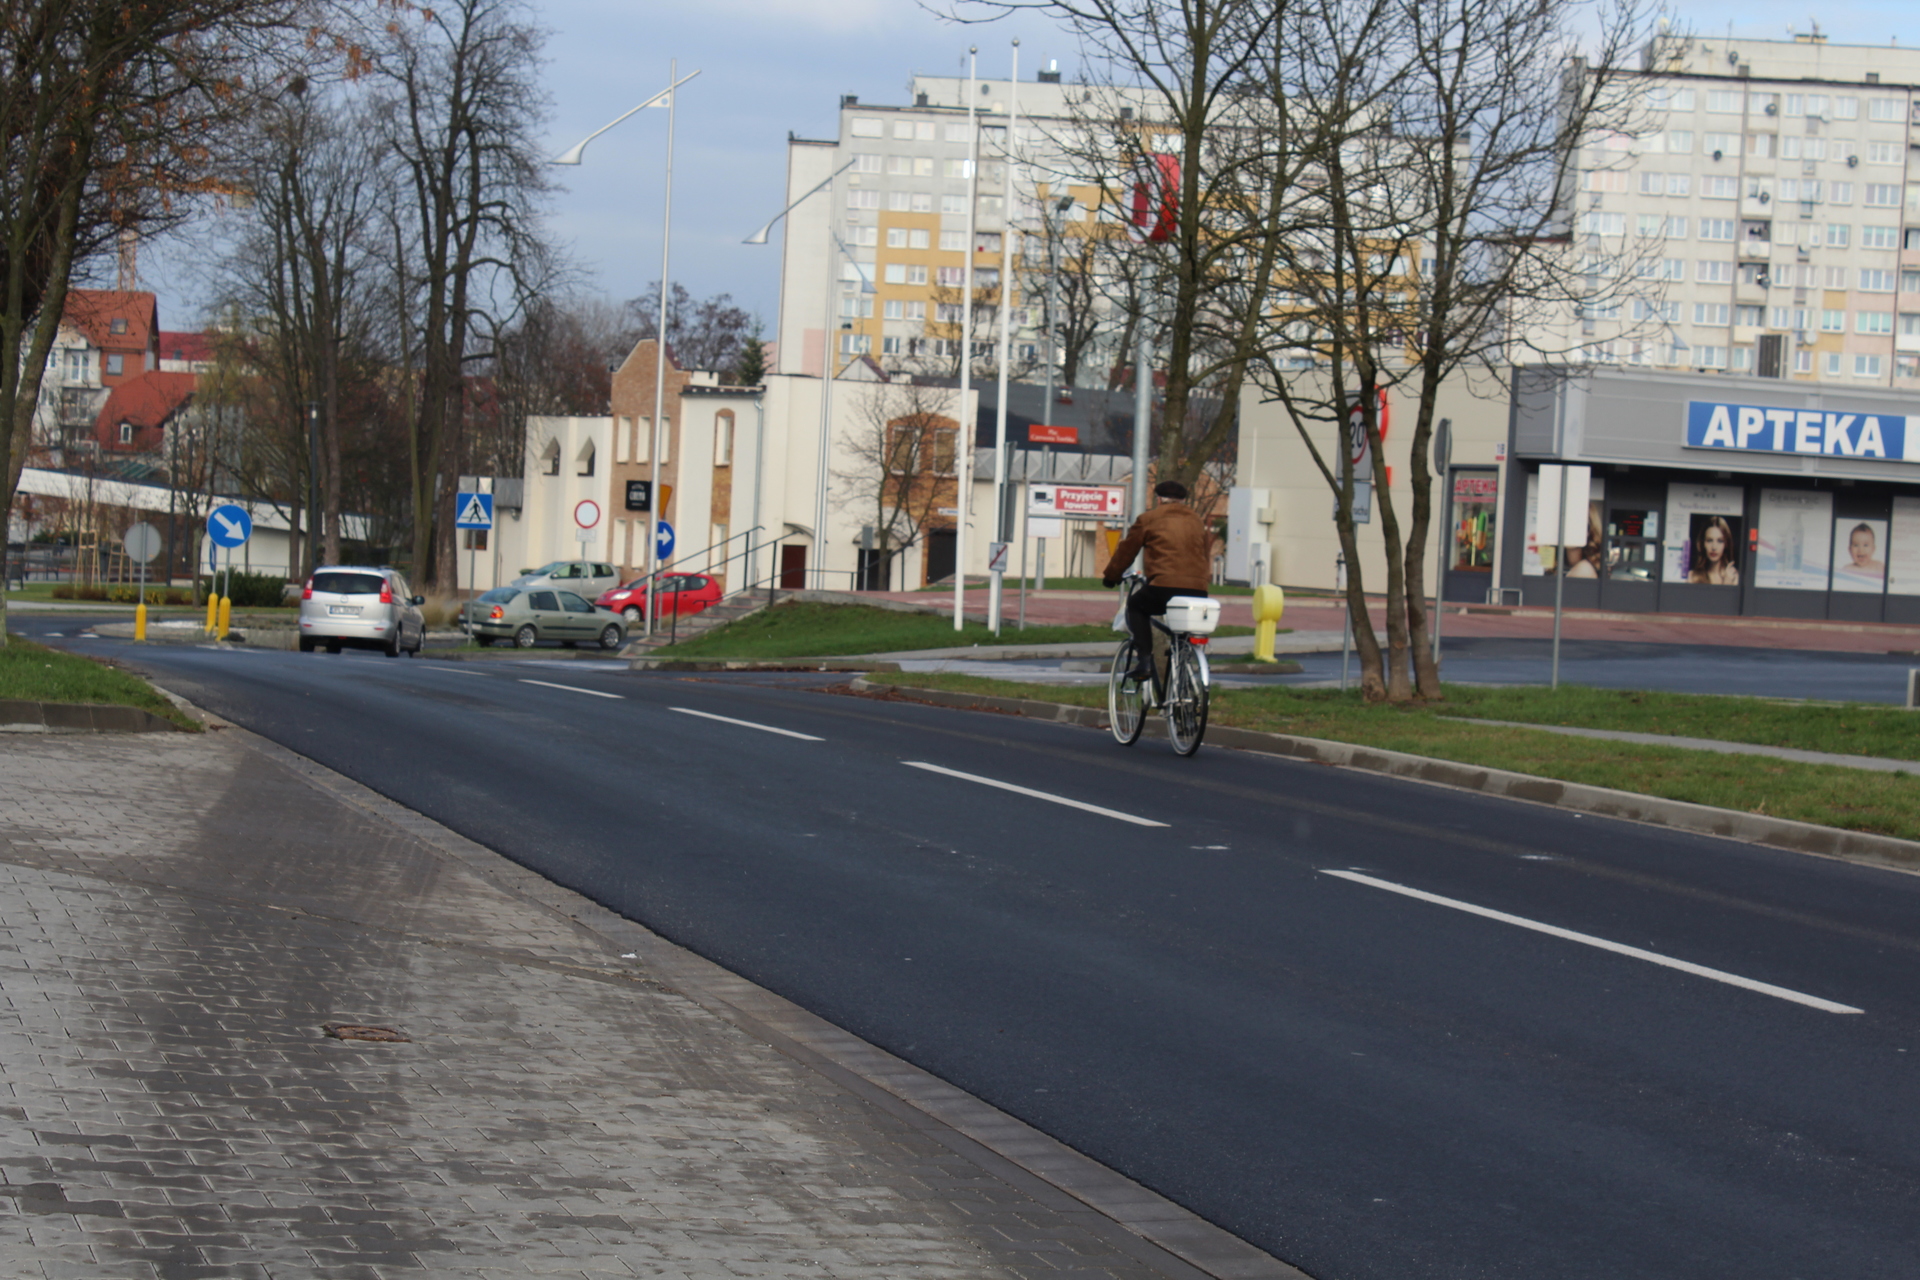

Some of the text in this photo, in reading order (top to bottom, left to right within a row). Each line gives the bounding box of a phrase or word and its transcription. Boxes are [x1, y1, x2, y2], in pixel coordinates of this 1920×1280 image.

[1702, 405, 1886, 458] APTEKA
[1454, 478, 1497, 493] APTEKA
[1060, 490, 1103, 502] Przyjęcie
[1064, 501, 1099, 510] towaru
